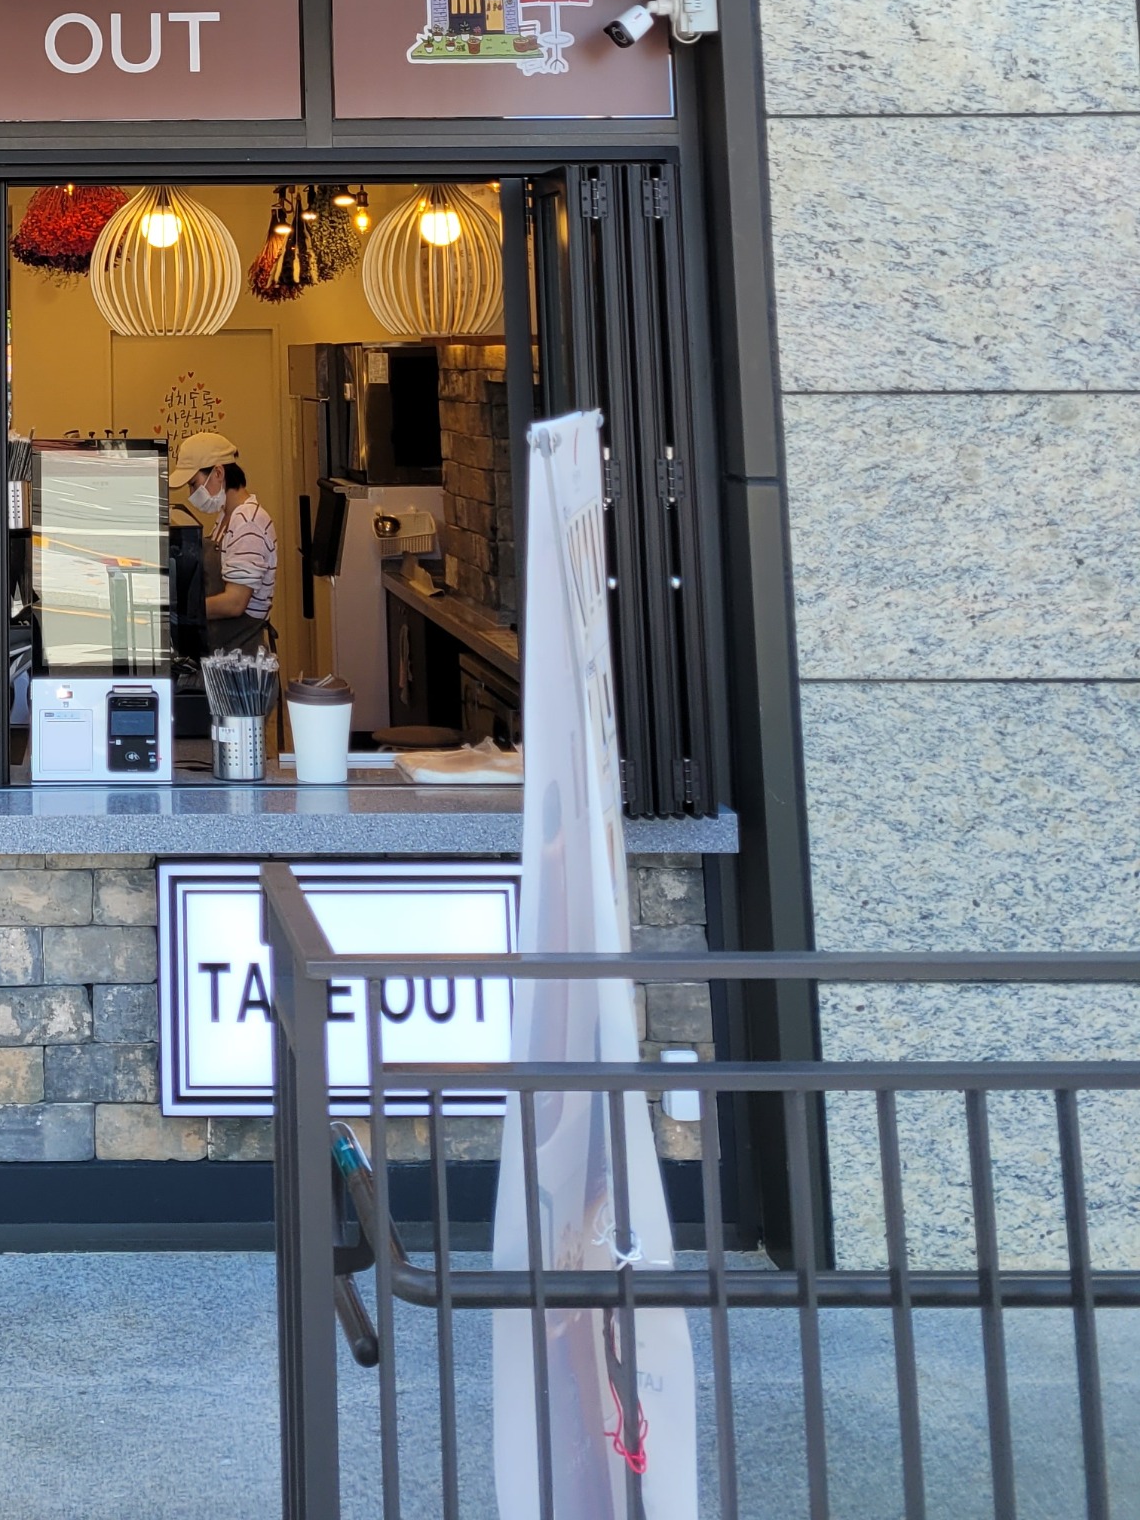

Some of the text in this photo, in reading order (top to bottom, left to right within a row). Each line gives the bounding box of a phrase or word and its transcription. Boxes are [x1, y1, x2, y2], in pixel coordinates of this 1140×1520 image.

[44, 12, 221, 74] OUT
[166, 410, 217, 428] 사랑하고
[198, 962, 356, 1023] TAE
